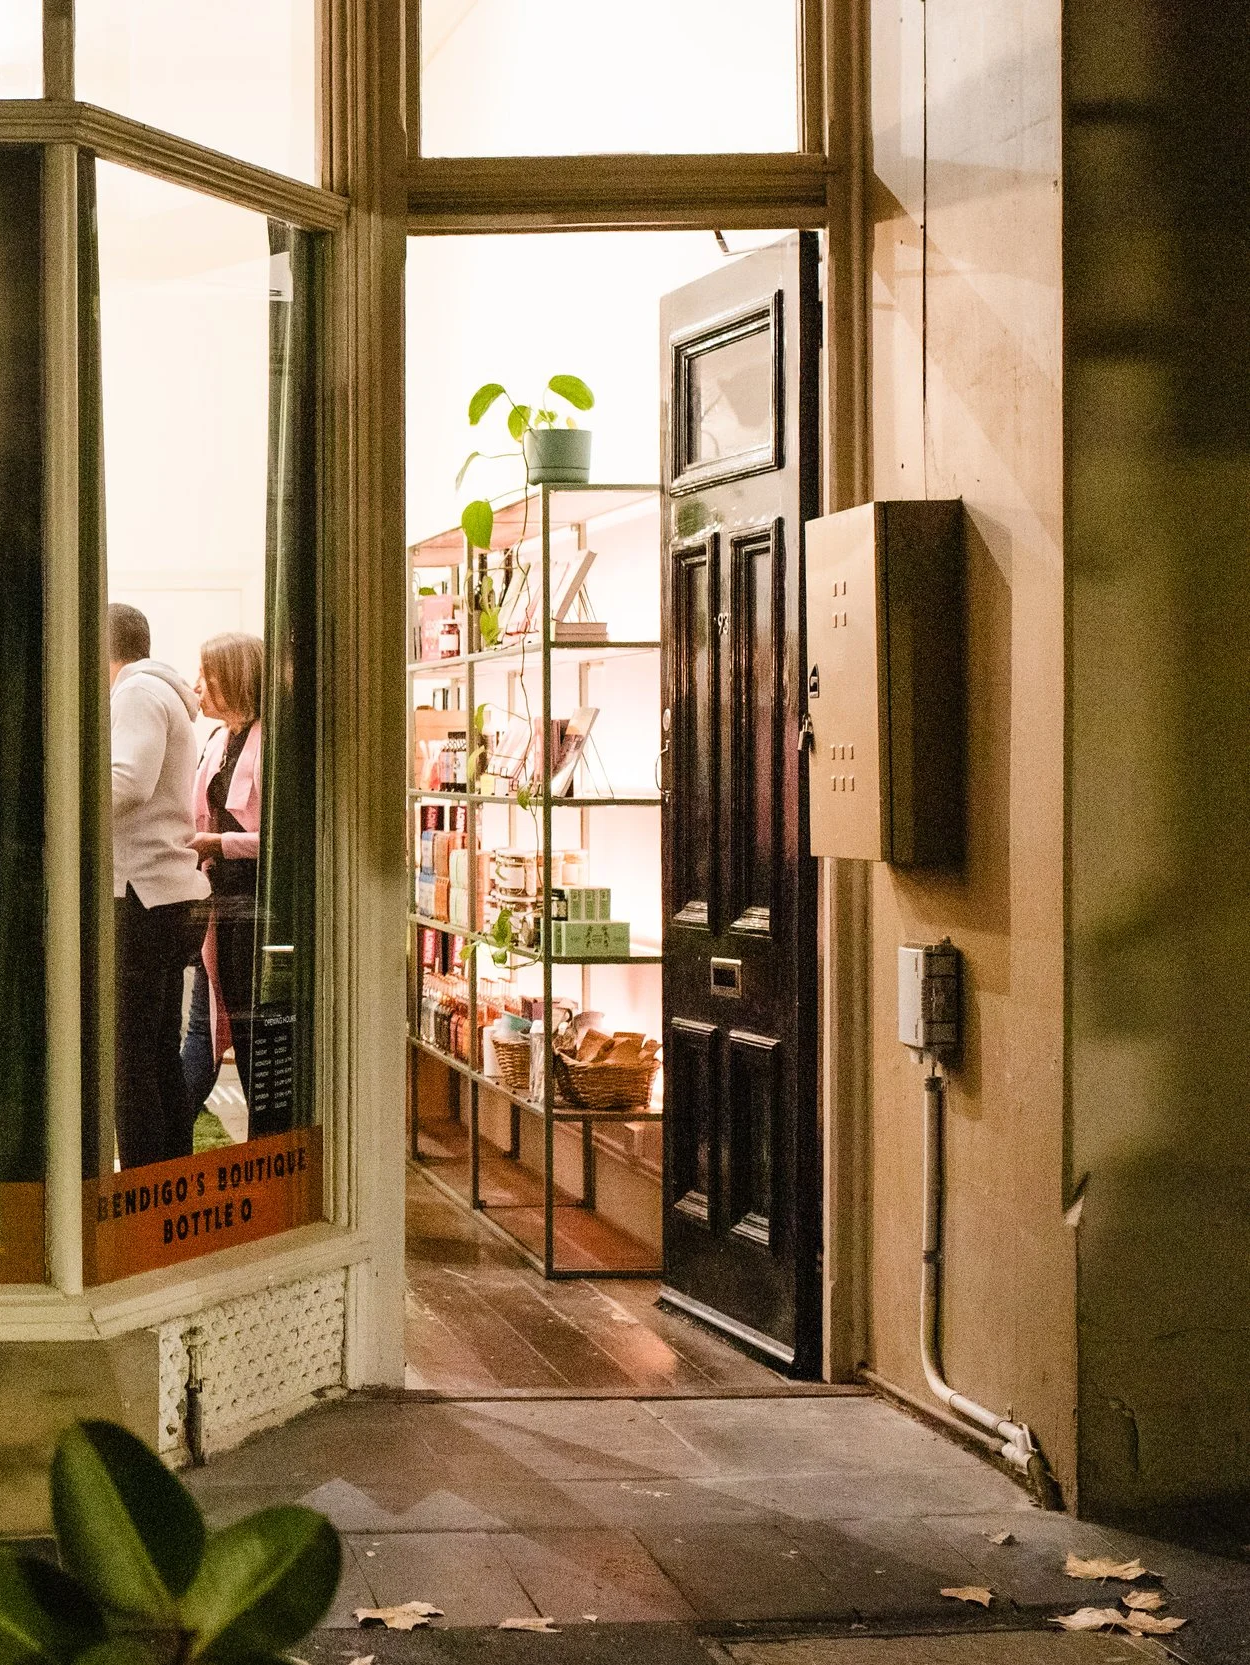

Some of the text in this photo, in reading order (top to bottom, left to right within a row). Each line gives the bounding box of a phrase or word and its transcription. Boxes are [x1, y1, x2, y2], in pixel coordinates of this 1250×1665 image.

[97, 1147, 307, 1222] BENDIGO'S BOUTIQUE
[163, 1202, 234, 1244] BOTTLE
